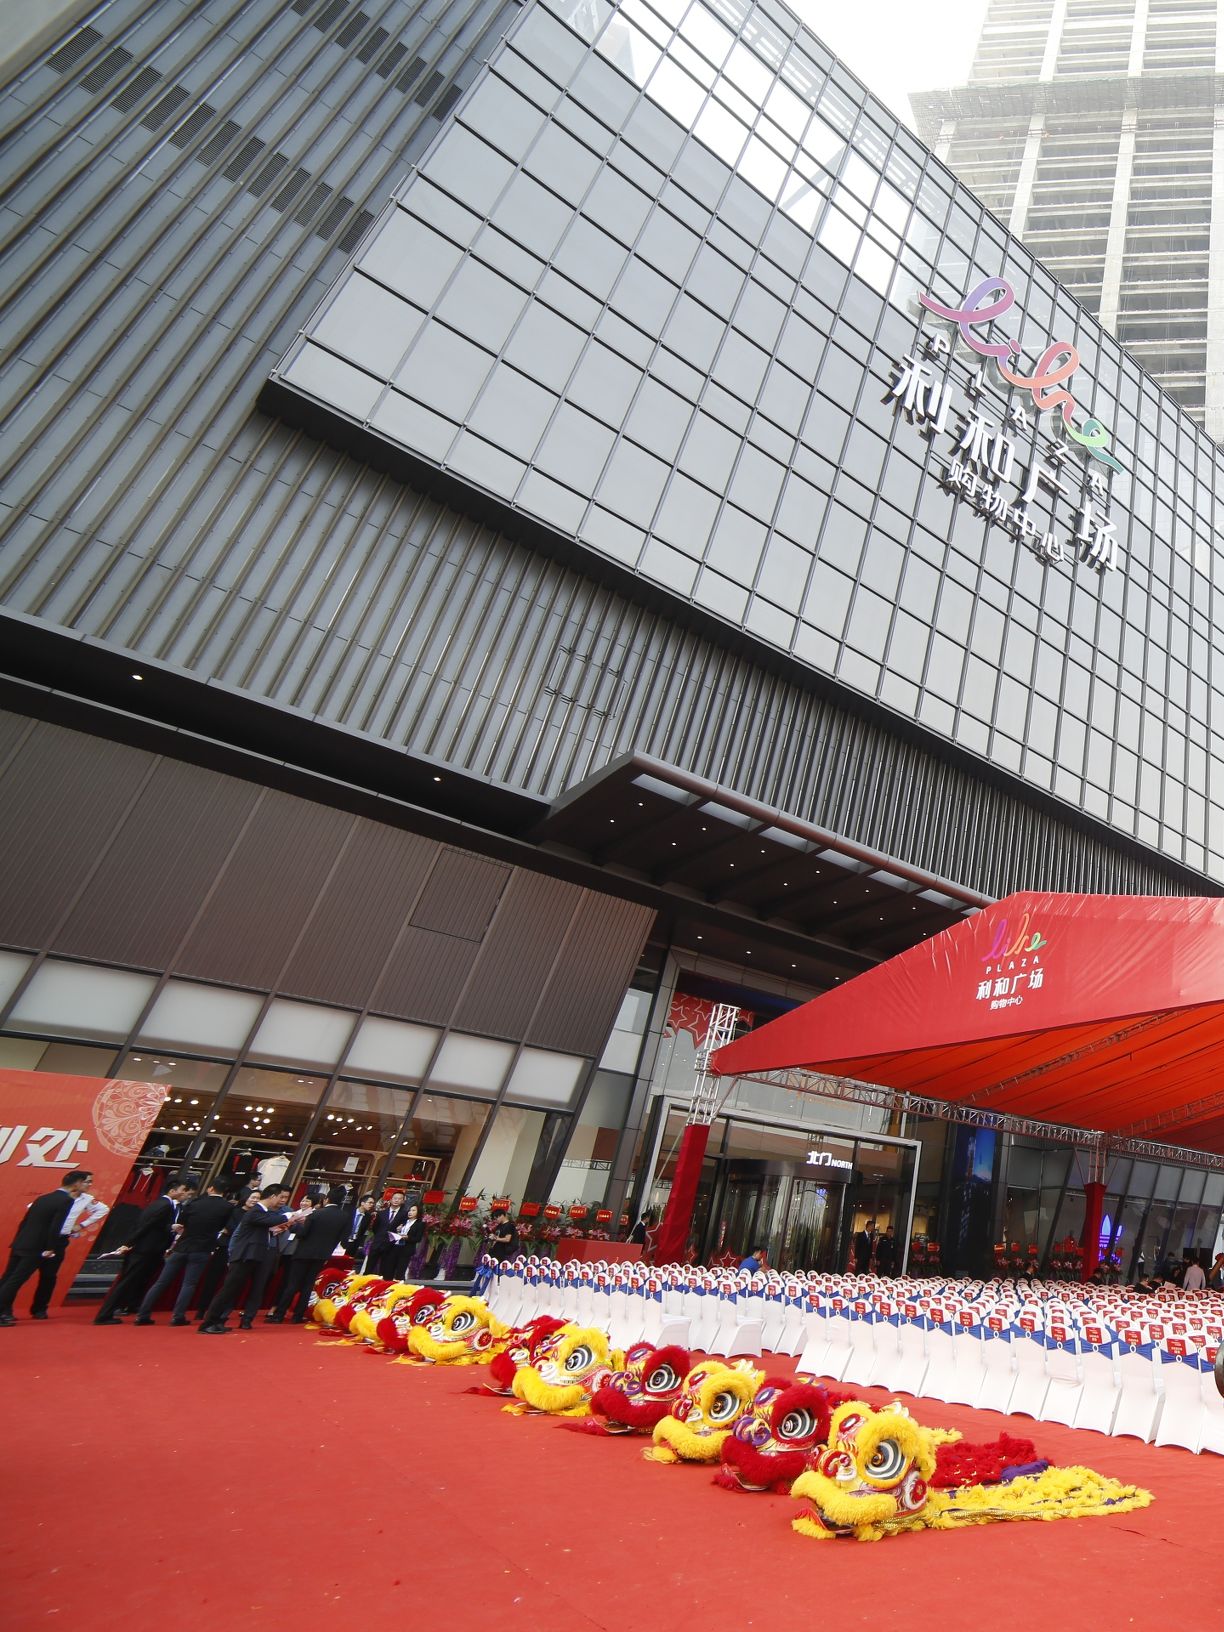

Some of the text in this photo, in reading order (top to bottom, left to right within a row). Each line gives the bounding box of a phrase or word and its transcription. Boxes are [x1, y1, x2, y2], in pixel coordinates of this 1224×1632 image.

[932, 333, 1105, 497] PLAZA
[890, 353, 1118, 573] 利和广场
[946, 458, 1067, 564] 购物中心
[985, 955, 1040, 974] PLAZA
[975, 967, 1044, 1001] 利和广场
[989, 995, 1024, 1011] 购物中心
[806, 1150, 853, 1170] 北门 NORTH
